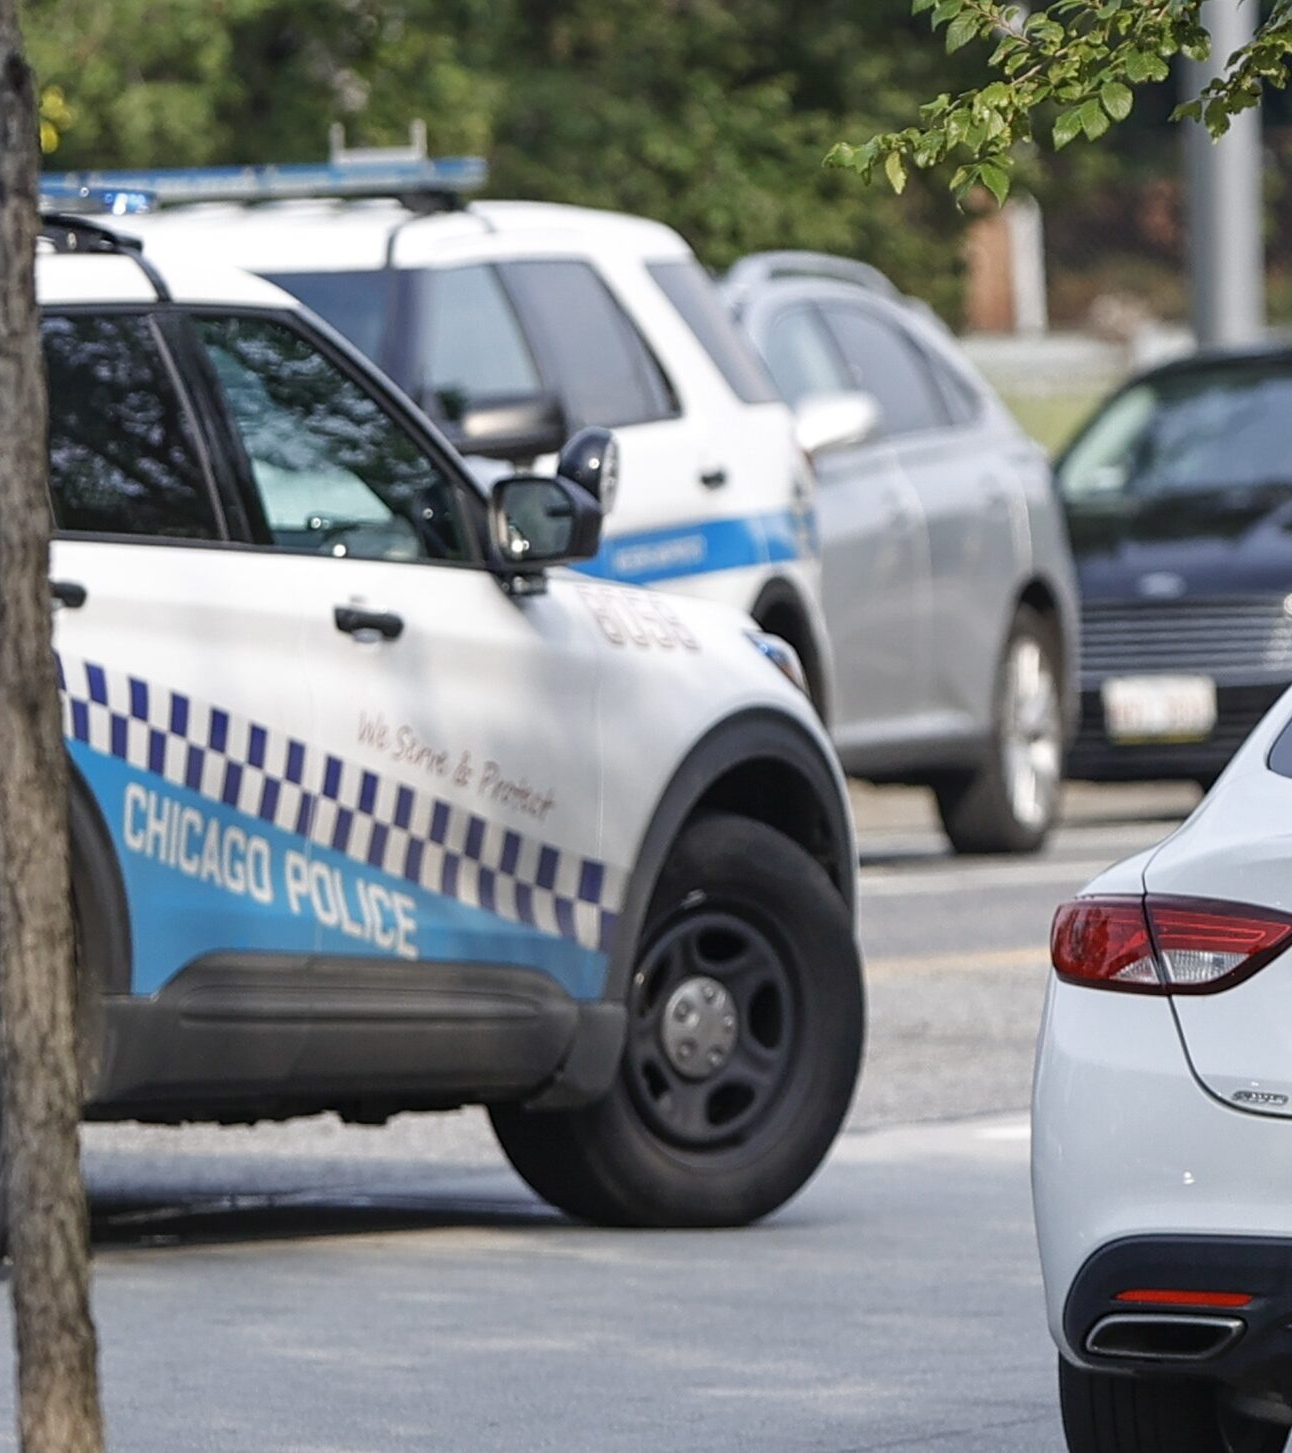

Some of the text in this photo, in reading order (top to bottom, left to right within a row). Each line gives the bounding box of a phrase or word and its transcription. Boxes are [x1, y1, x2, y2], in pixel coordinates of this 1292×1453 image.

[358, 709, 389, 748] We
[124, 782, 419, 960] CHICAGO POLICE
